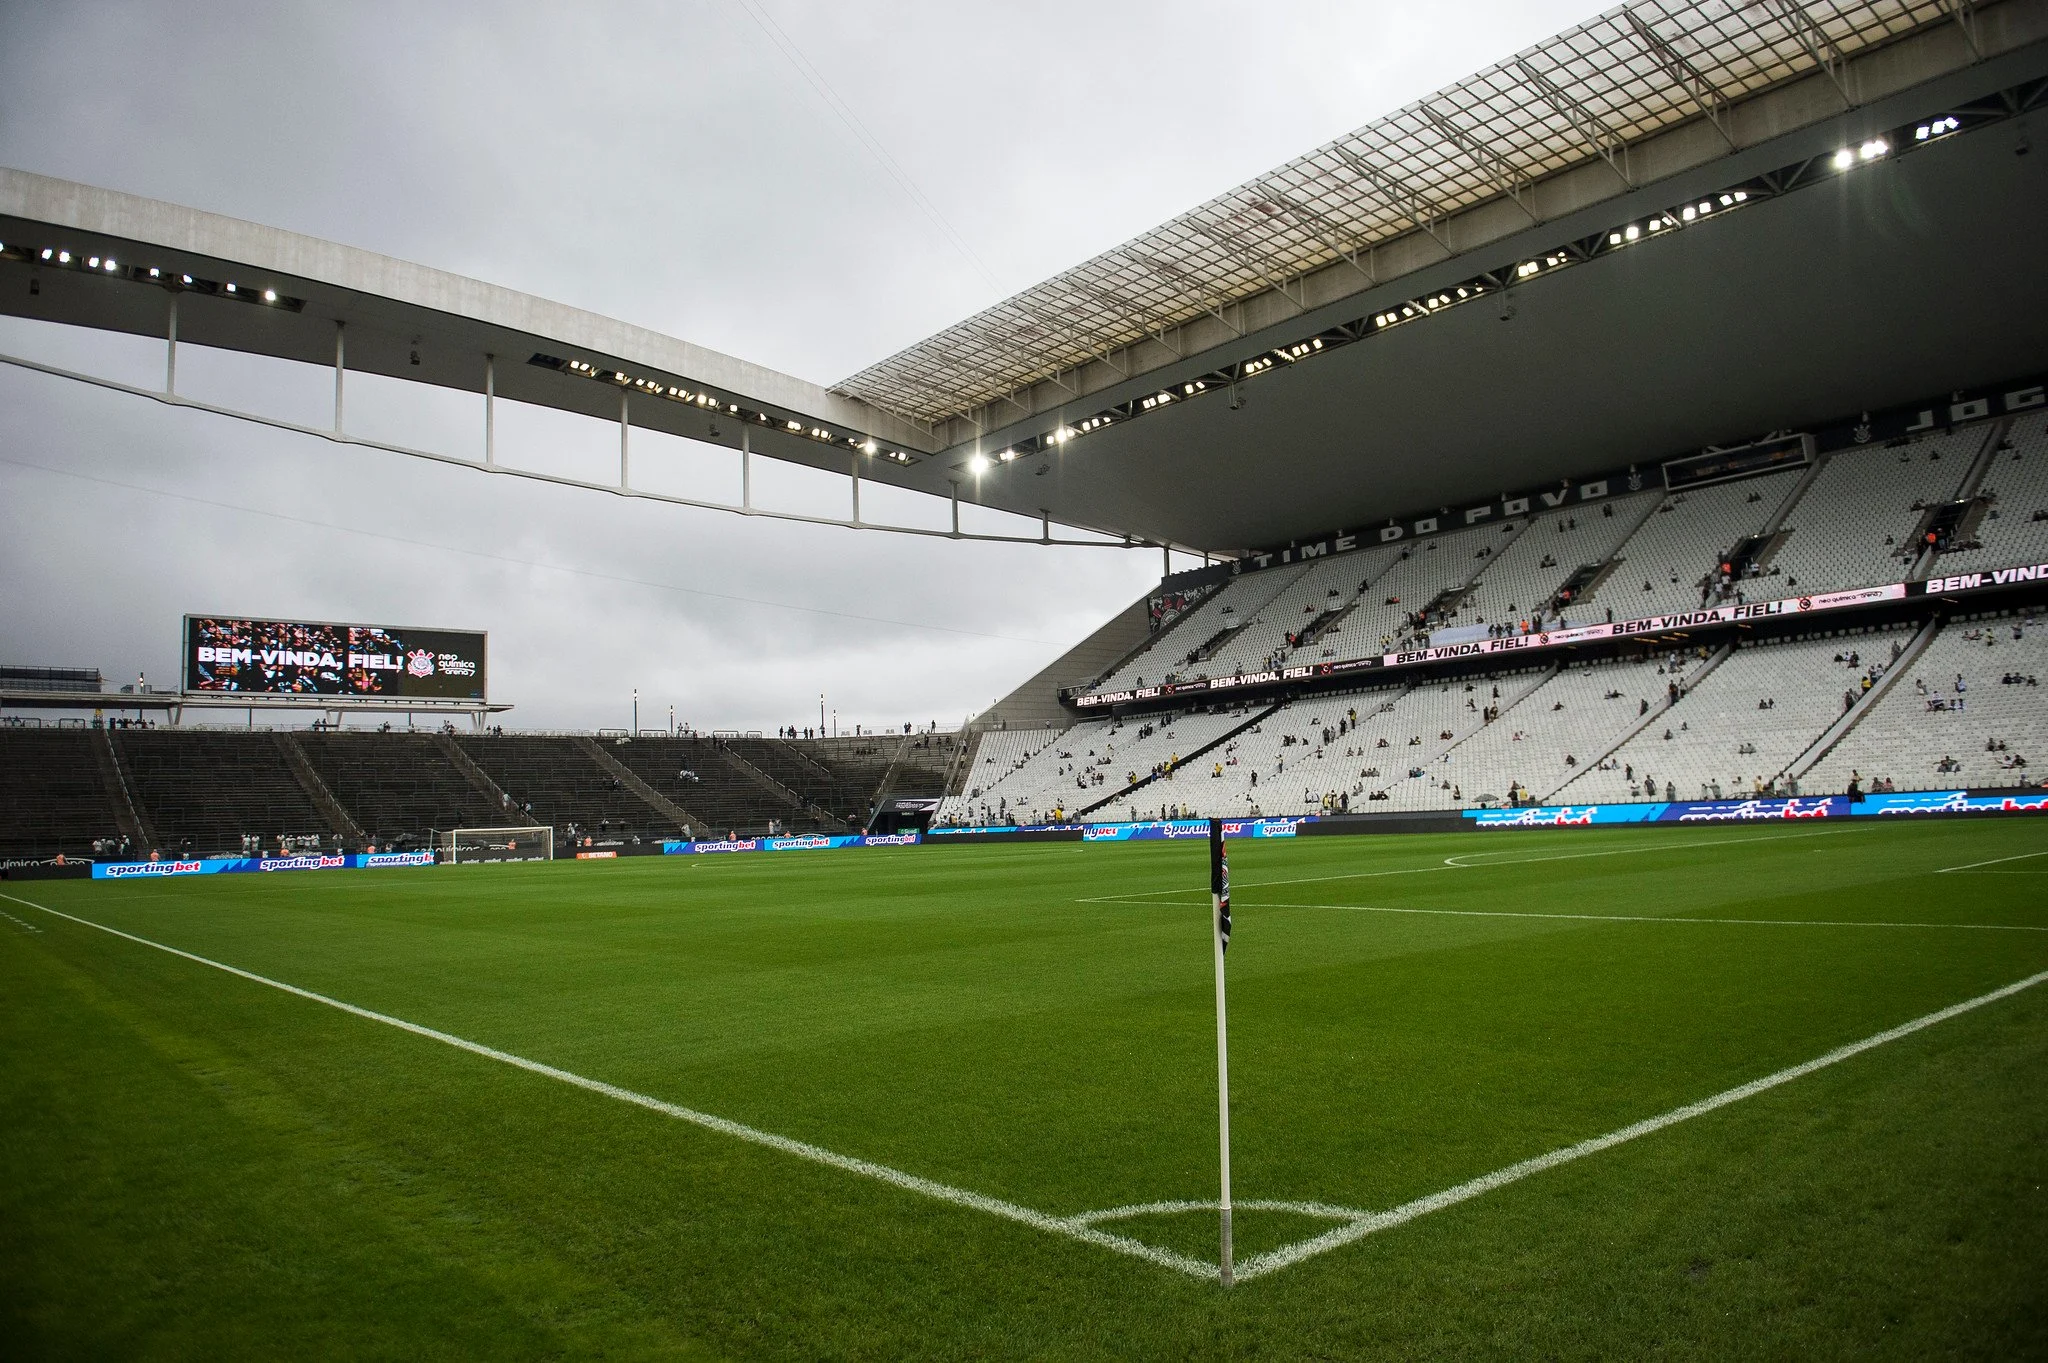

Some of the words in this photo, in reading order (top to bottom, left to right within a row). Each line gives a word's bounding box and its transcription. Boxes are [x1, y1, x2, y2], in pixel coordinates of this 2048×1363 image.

[1254, 535, 1356, 568] TIME
[1381, 517, 1438, 542] DO
[1465, 480, 1608, 525] POVO
[1612, 610, 1726, 635] BEM-VINDA,
[1733, 601, 1783, 619] FIEL!
[198, 646, 343, 671] BEM-VINDA,
[348, 653, 404, 670] FIEL!
[438, 653, 458, 661] neo
[1396, 643, 1485, 664] BEM-VINDA,
[1490, 636, 1528, 651] FIEL!
[1210, 672, 1280, 689] BEM-VINDA,
[1282, 666, 1313, 680] FIEL!
[1076, 691, 1133, 707] BEM-VINDA,
[1135, 687, 1160, 699] FIEL!
[695, 840, 756, 853] sportingbet
[773, 837, 830, 849] sportingbet
[866, 834, 916, 846] sportingbet
[107, 861, 201, 876] sportingbet
[261, 857, 344, 871] sportingbet
